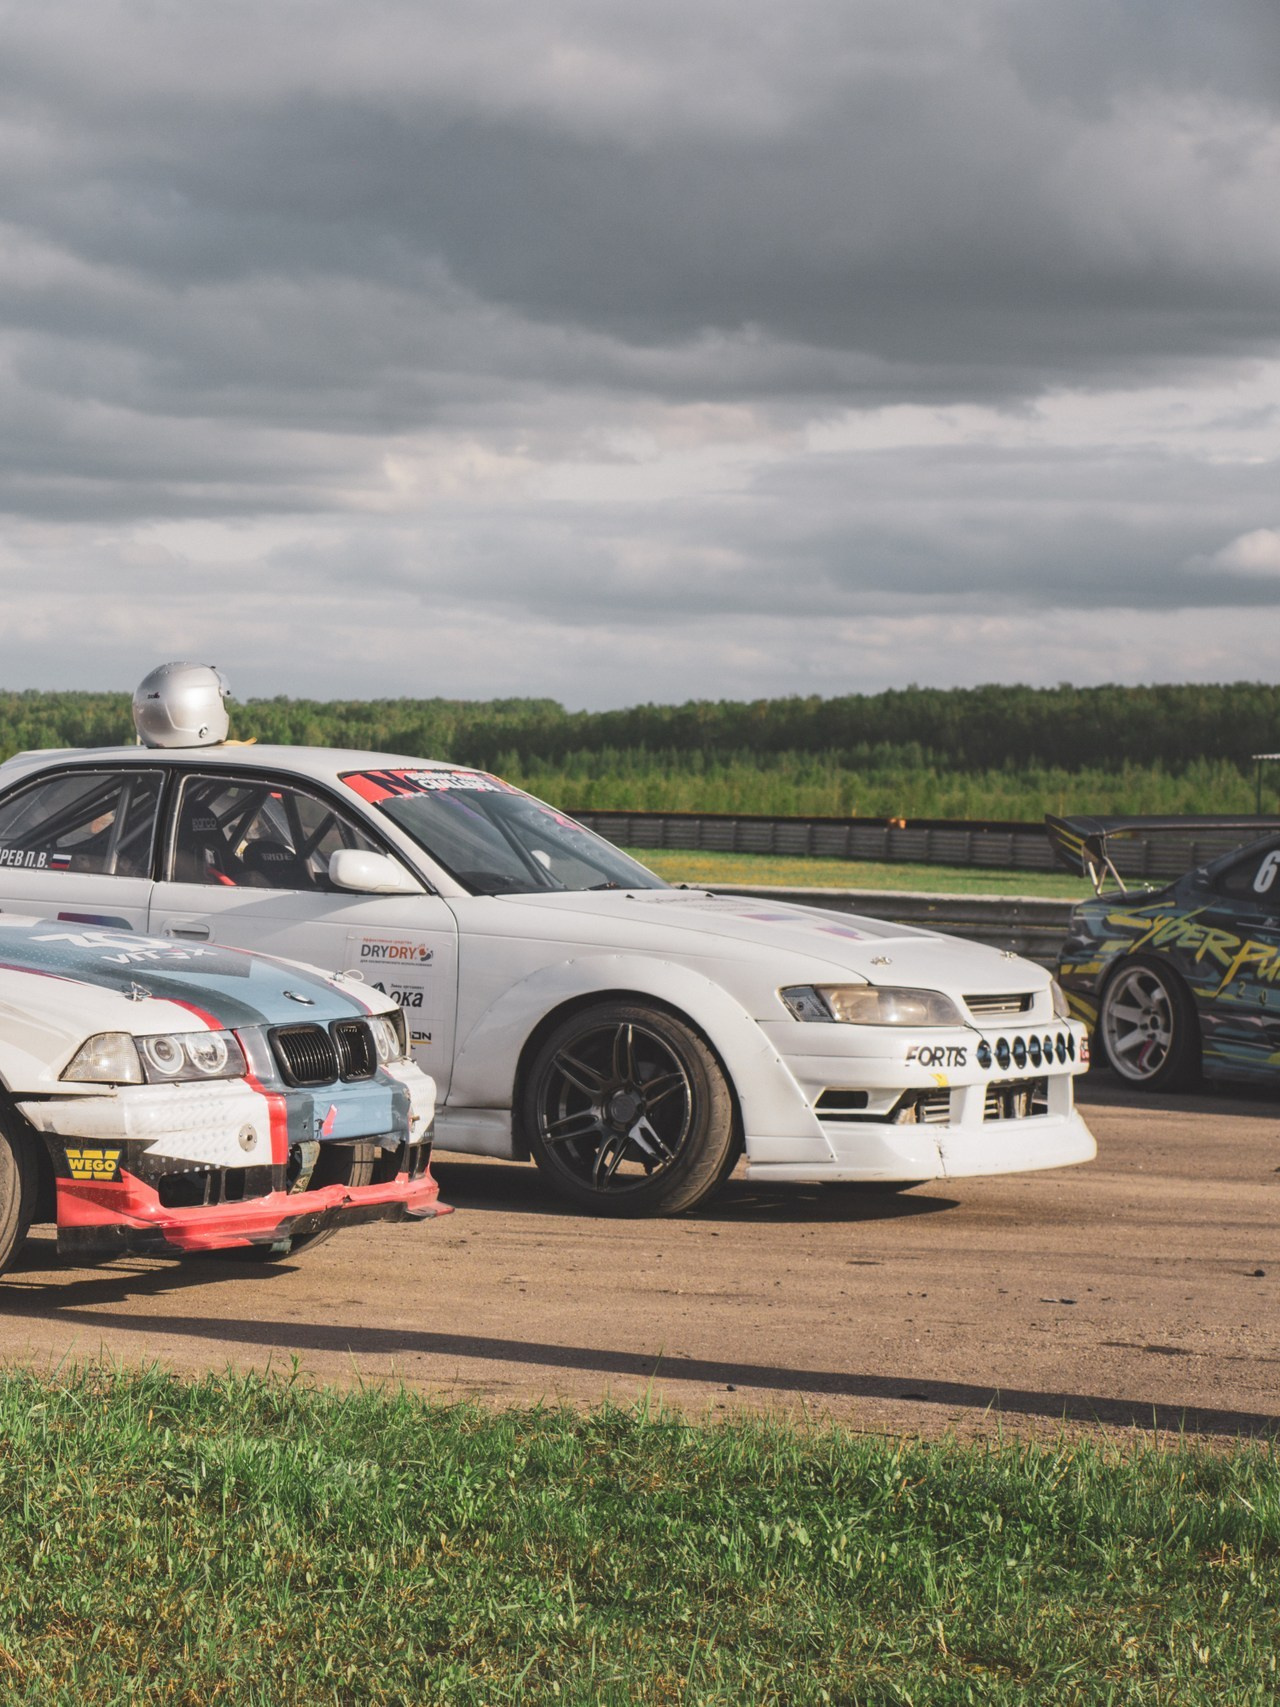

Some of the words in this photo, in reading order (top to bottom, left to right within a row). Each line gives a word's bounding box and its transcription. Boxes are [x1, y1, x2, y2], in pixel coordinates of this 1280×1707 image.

[24, 851, 49, 868] П.В.
[360, 944, 417, 960] DRYDRY
[905, 1046, 968, 1067] FORTIS
[68, 1158, 117, 1172] WEGO
